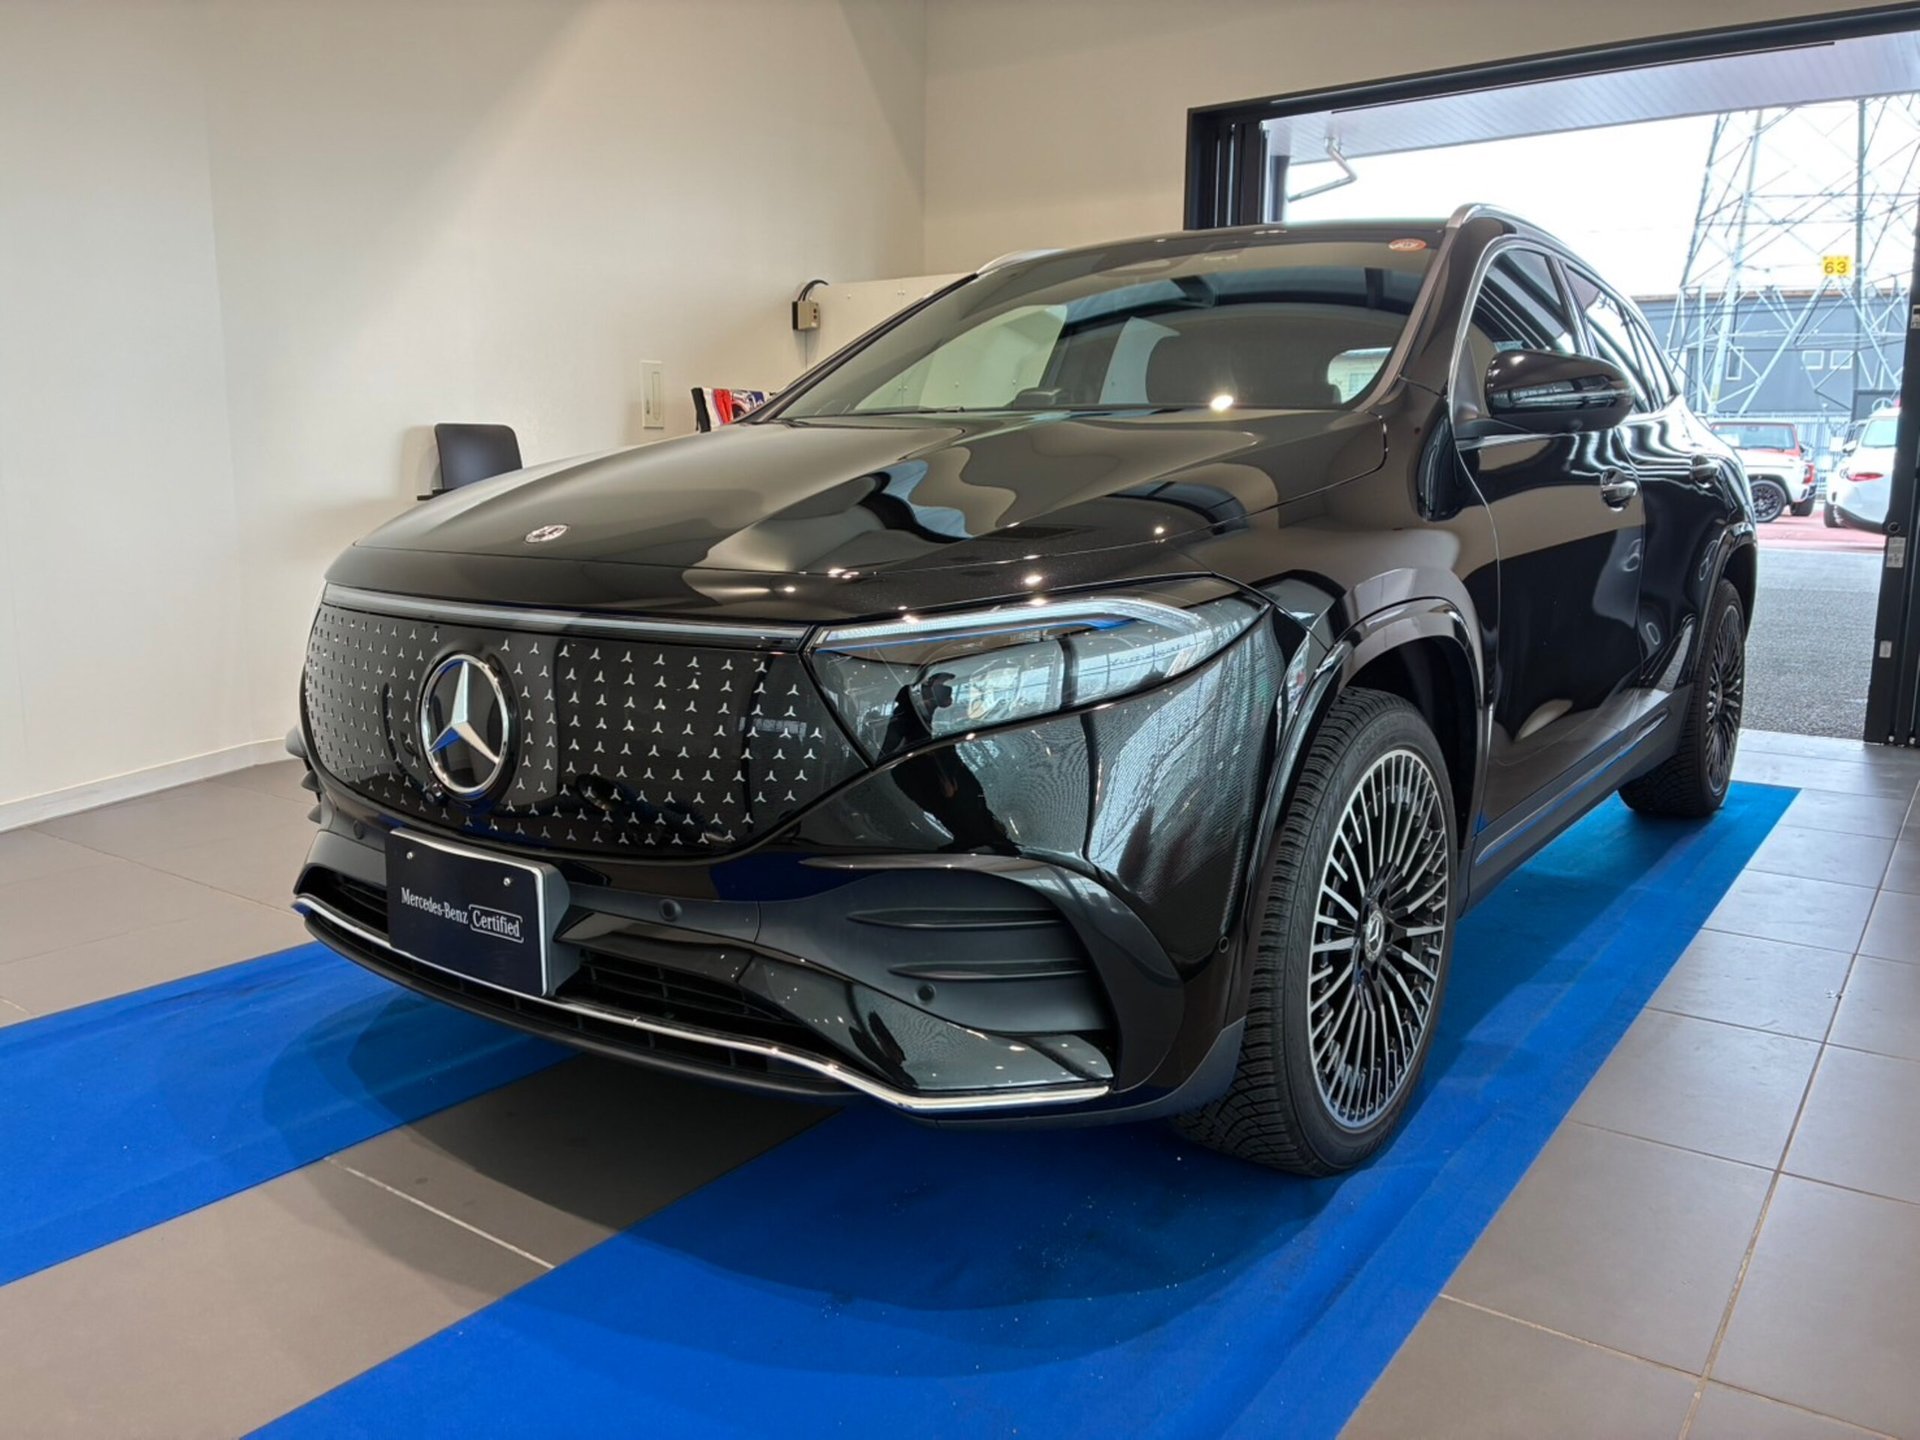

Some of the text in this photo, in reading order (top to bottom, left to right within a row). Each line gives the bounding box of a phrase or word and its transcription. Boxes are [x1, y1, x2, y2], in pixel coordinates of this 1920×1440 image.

[1824, 261, 1847, 274] 63
[401, 887, 521, 938] Mercedes-Benz Certified
